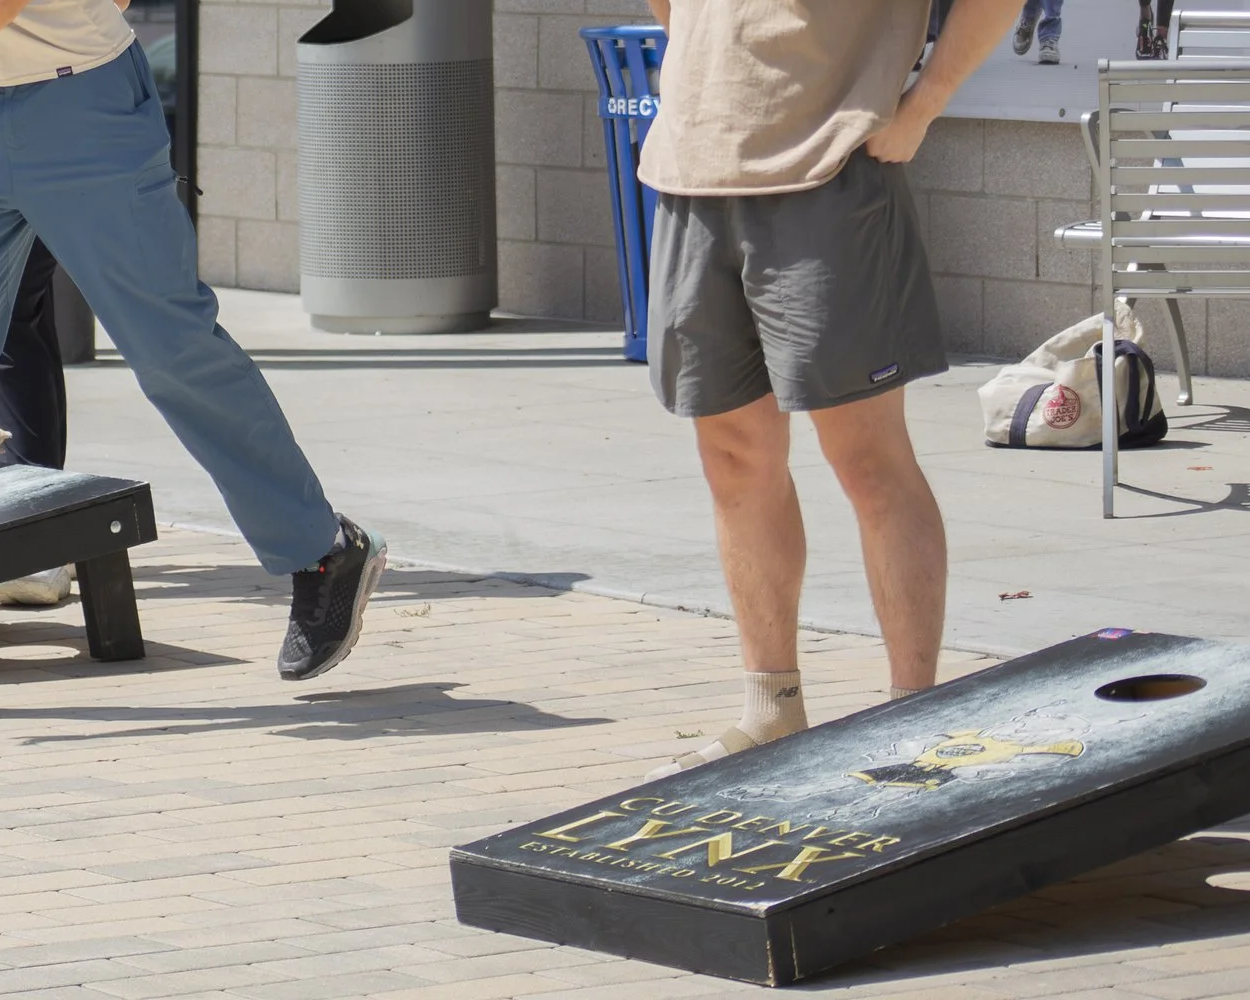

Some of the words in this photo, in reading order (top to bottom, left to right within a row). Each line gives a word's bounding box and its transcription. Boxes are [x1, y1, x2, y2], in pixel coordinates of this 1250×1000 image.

[531, 809, 867, 882] LYNX
[618, 797, 699, 816] CU
[694, 809, 902, 853] DENVER
[518, 840, 697, 879] ESTABLISHED
[699, 873, 766, 891] 2012
